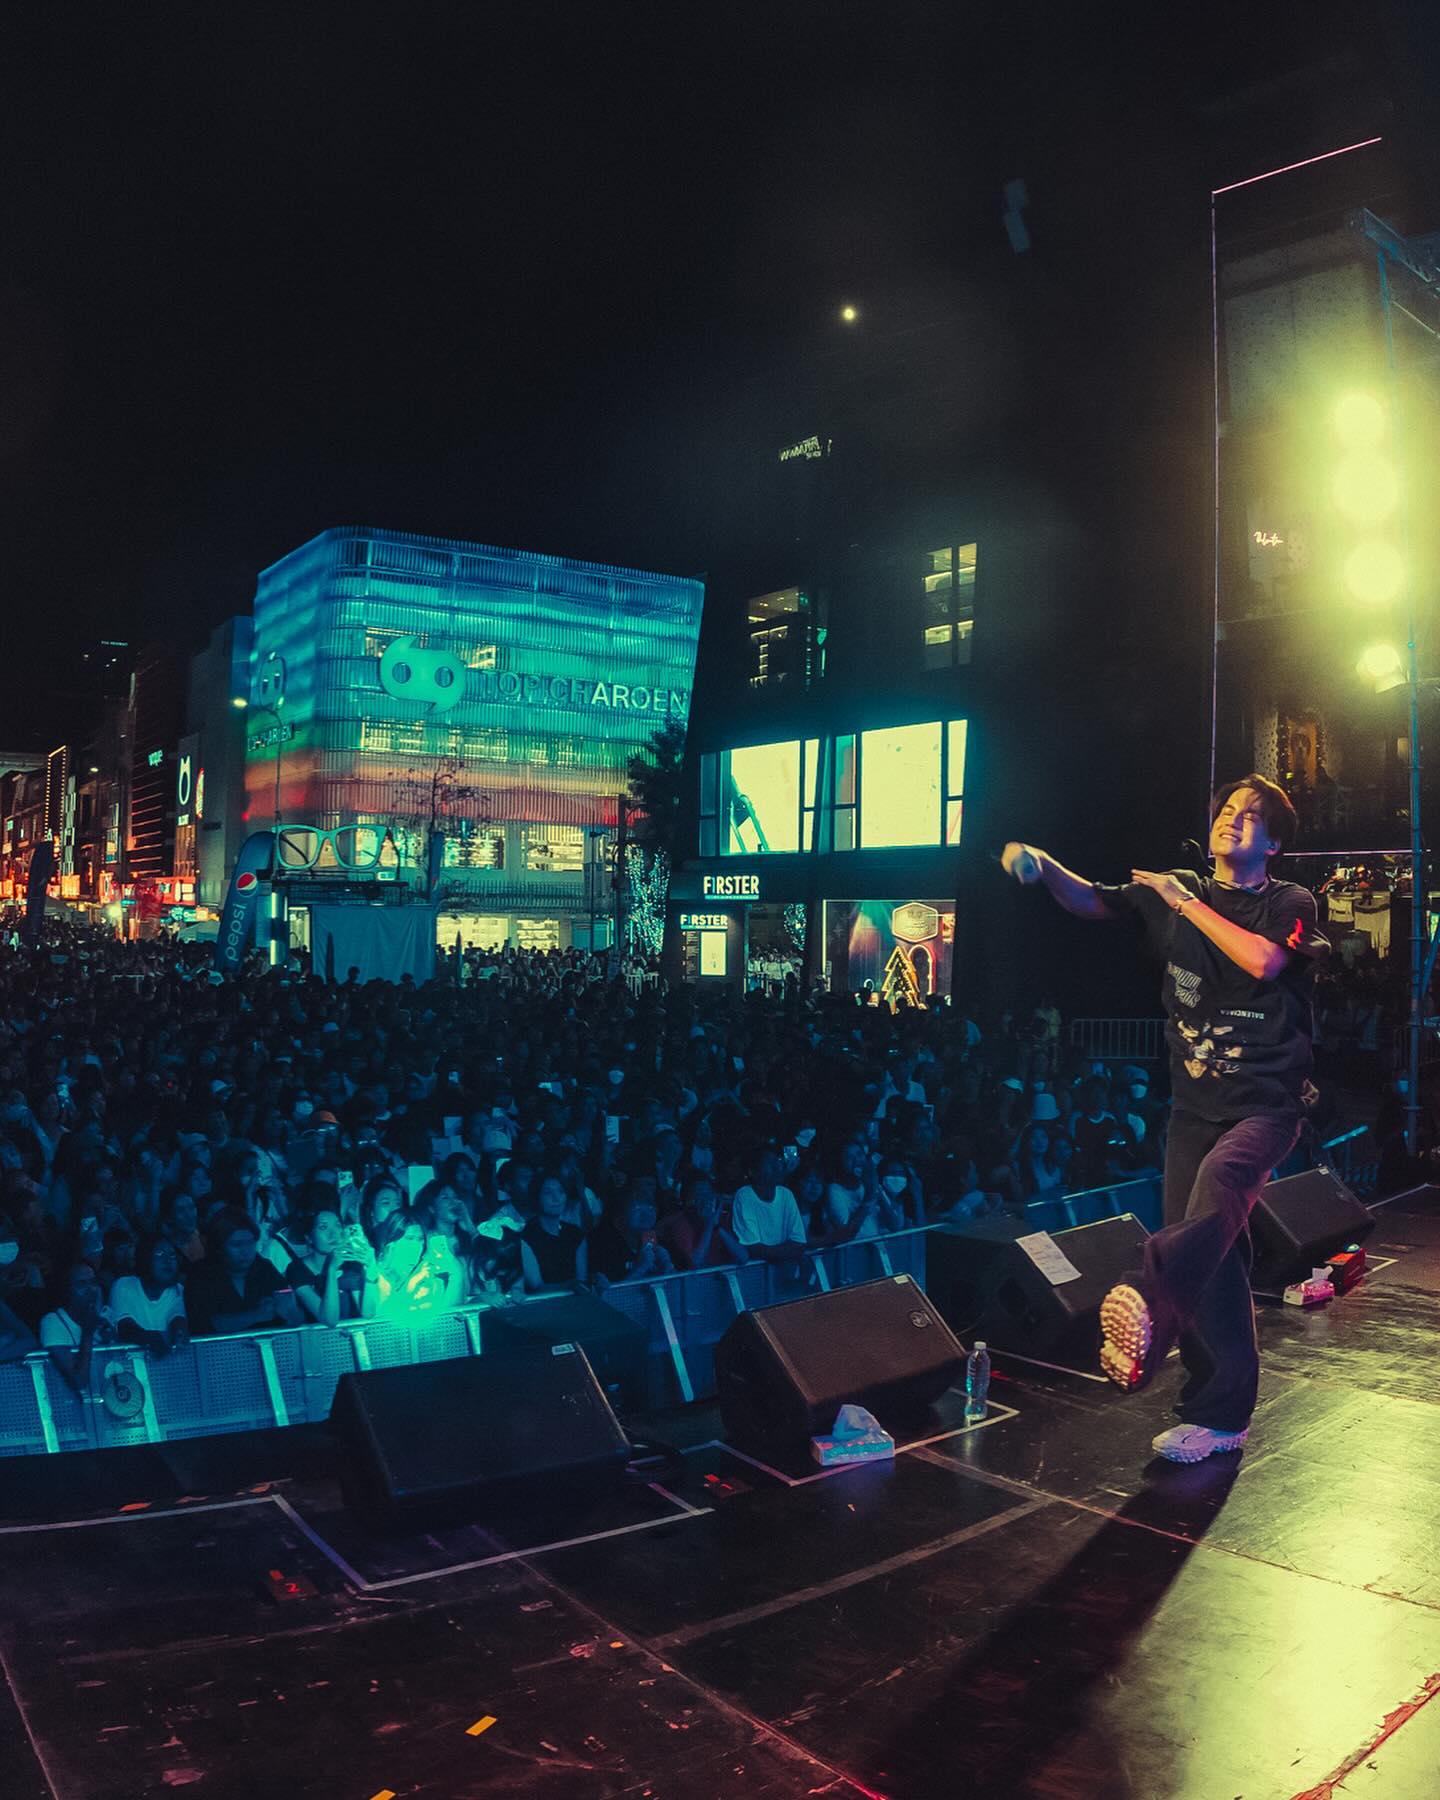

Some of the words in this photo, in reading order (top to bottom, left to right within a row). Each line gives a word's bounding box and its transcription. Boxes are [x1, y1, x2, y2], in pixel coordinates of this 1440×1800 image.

[482, 669, 541, 700] TOP
[547, 677, 687, 714] CHAROEN
[225, 903, 248, 962] pepsi
